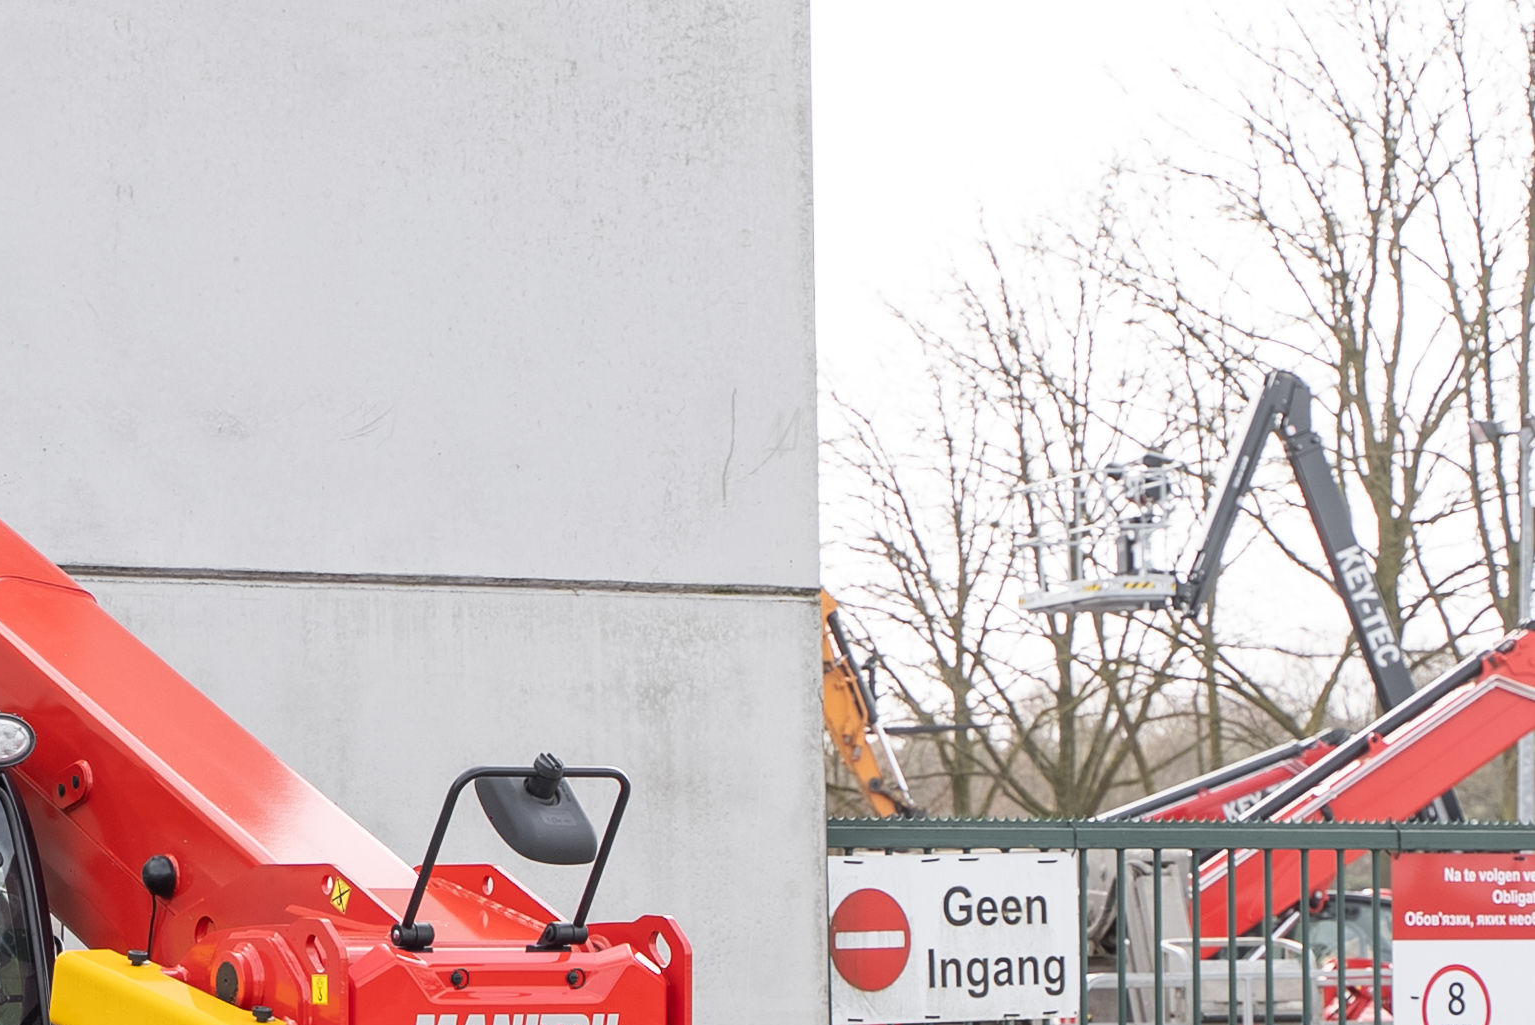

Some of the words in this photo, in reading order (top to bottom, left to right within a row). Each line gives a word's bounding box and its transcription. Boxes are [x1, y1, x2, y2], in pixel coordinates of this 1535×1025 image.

[1336, 545, 1401, 668] KEY-TEC
[1444, 867, 1462, 882] Na
[1464, 868, 1476, 882] te
[1478, 867, 1521, 885] volgen
[943, 886, 1048, 927] Geen
[928, 948, 1065, 998] Ingang
[1448, 982, 1465, 1016] 8
